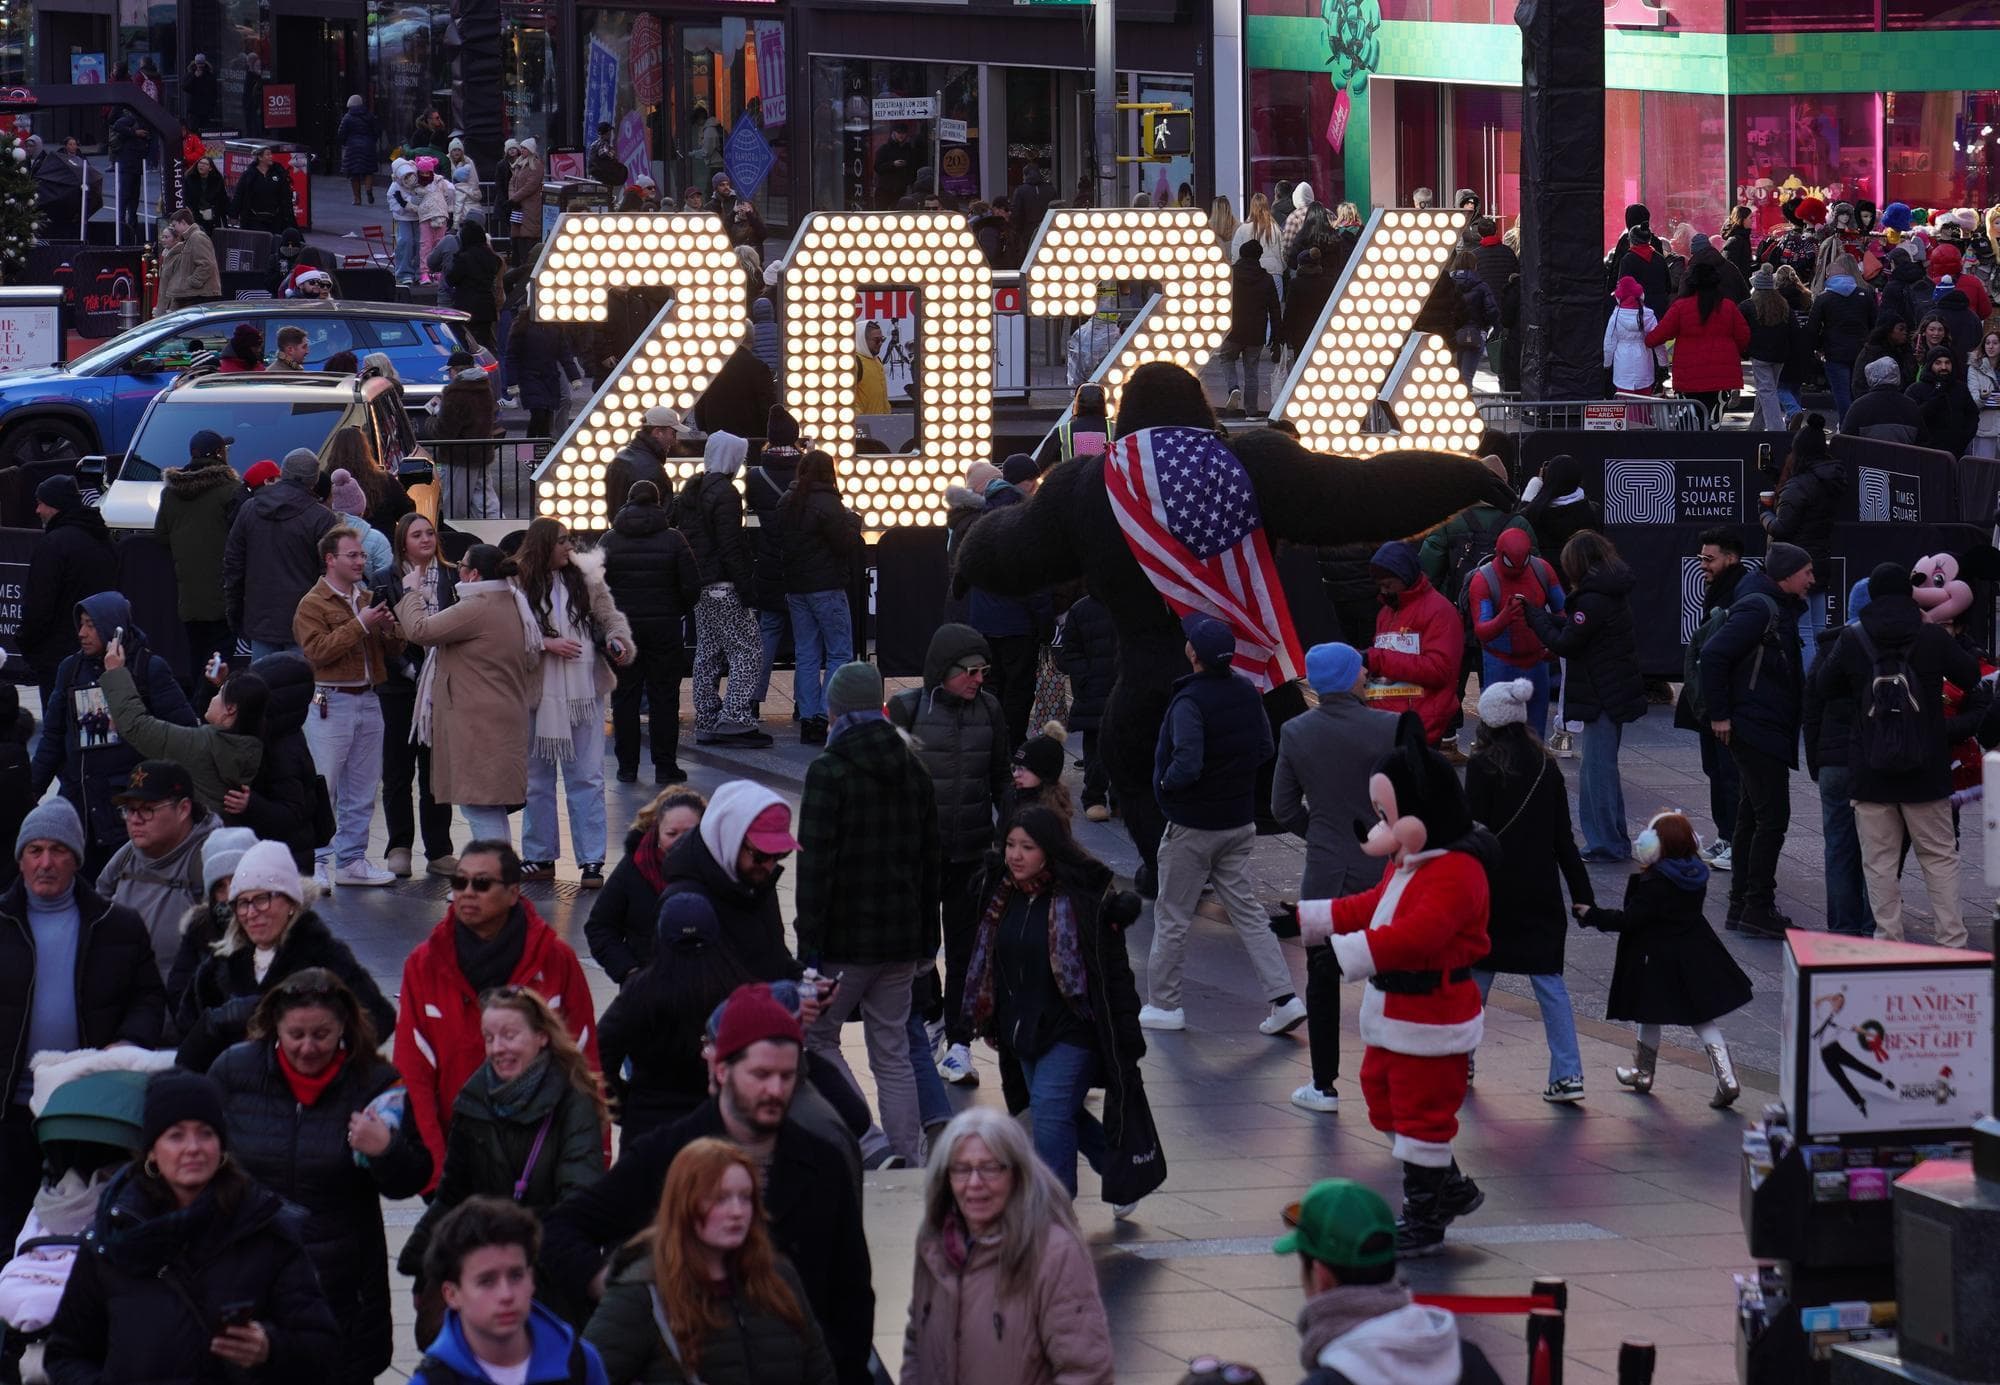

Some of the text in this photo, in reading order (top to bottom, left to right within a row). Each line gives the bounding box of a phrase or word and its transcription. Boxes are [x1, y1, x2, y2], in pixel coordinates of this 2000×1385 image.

[765, 100, 785, 120] NYC
[874, 101, 902, 109] PEDESTRIAN
[888, 109, 904, 117] MOVING
[530, 207, 1485, 535] 2026
[1686, 476, 1731, 488] TIMES
[1681, 491, 1736, 505] SQUARE
[1895, 490, 1915, 506] TIMES
[1685, 506, 1733, 516] ALLIANCE
[1892, 506, 1919, 522] SQUARE
[1886, 992, 1978, 1014] FUNNIEST
[1885, 1028, 1977, 1050] BEST GIFT
